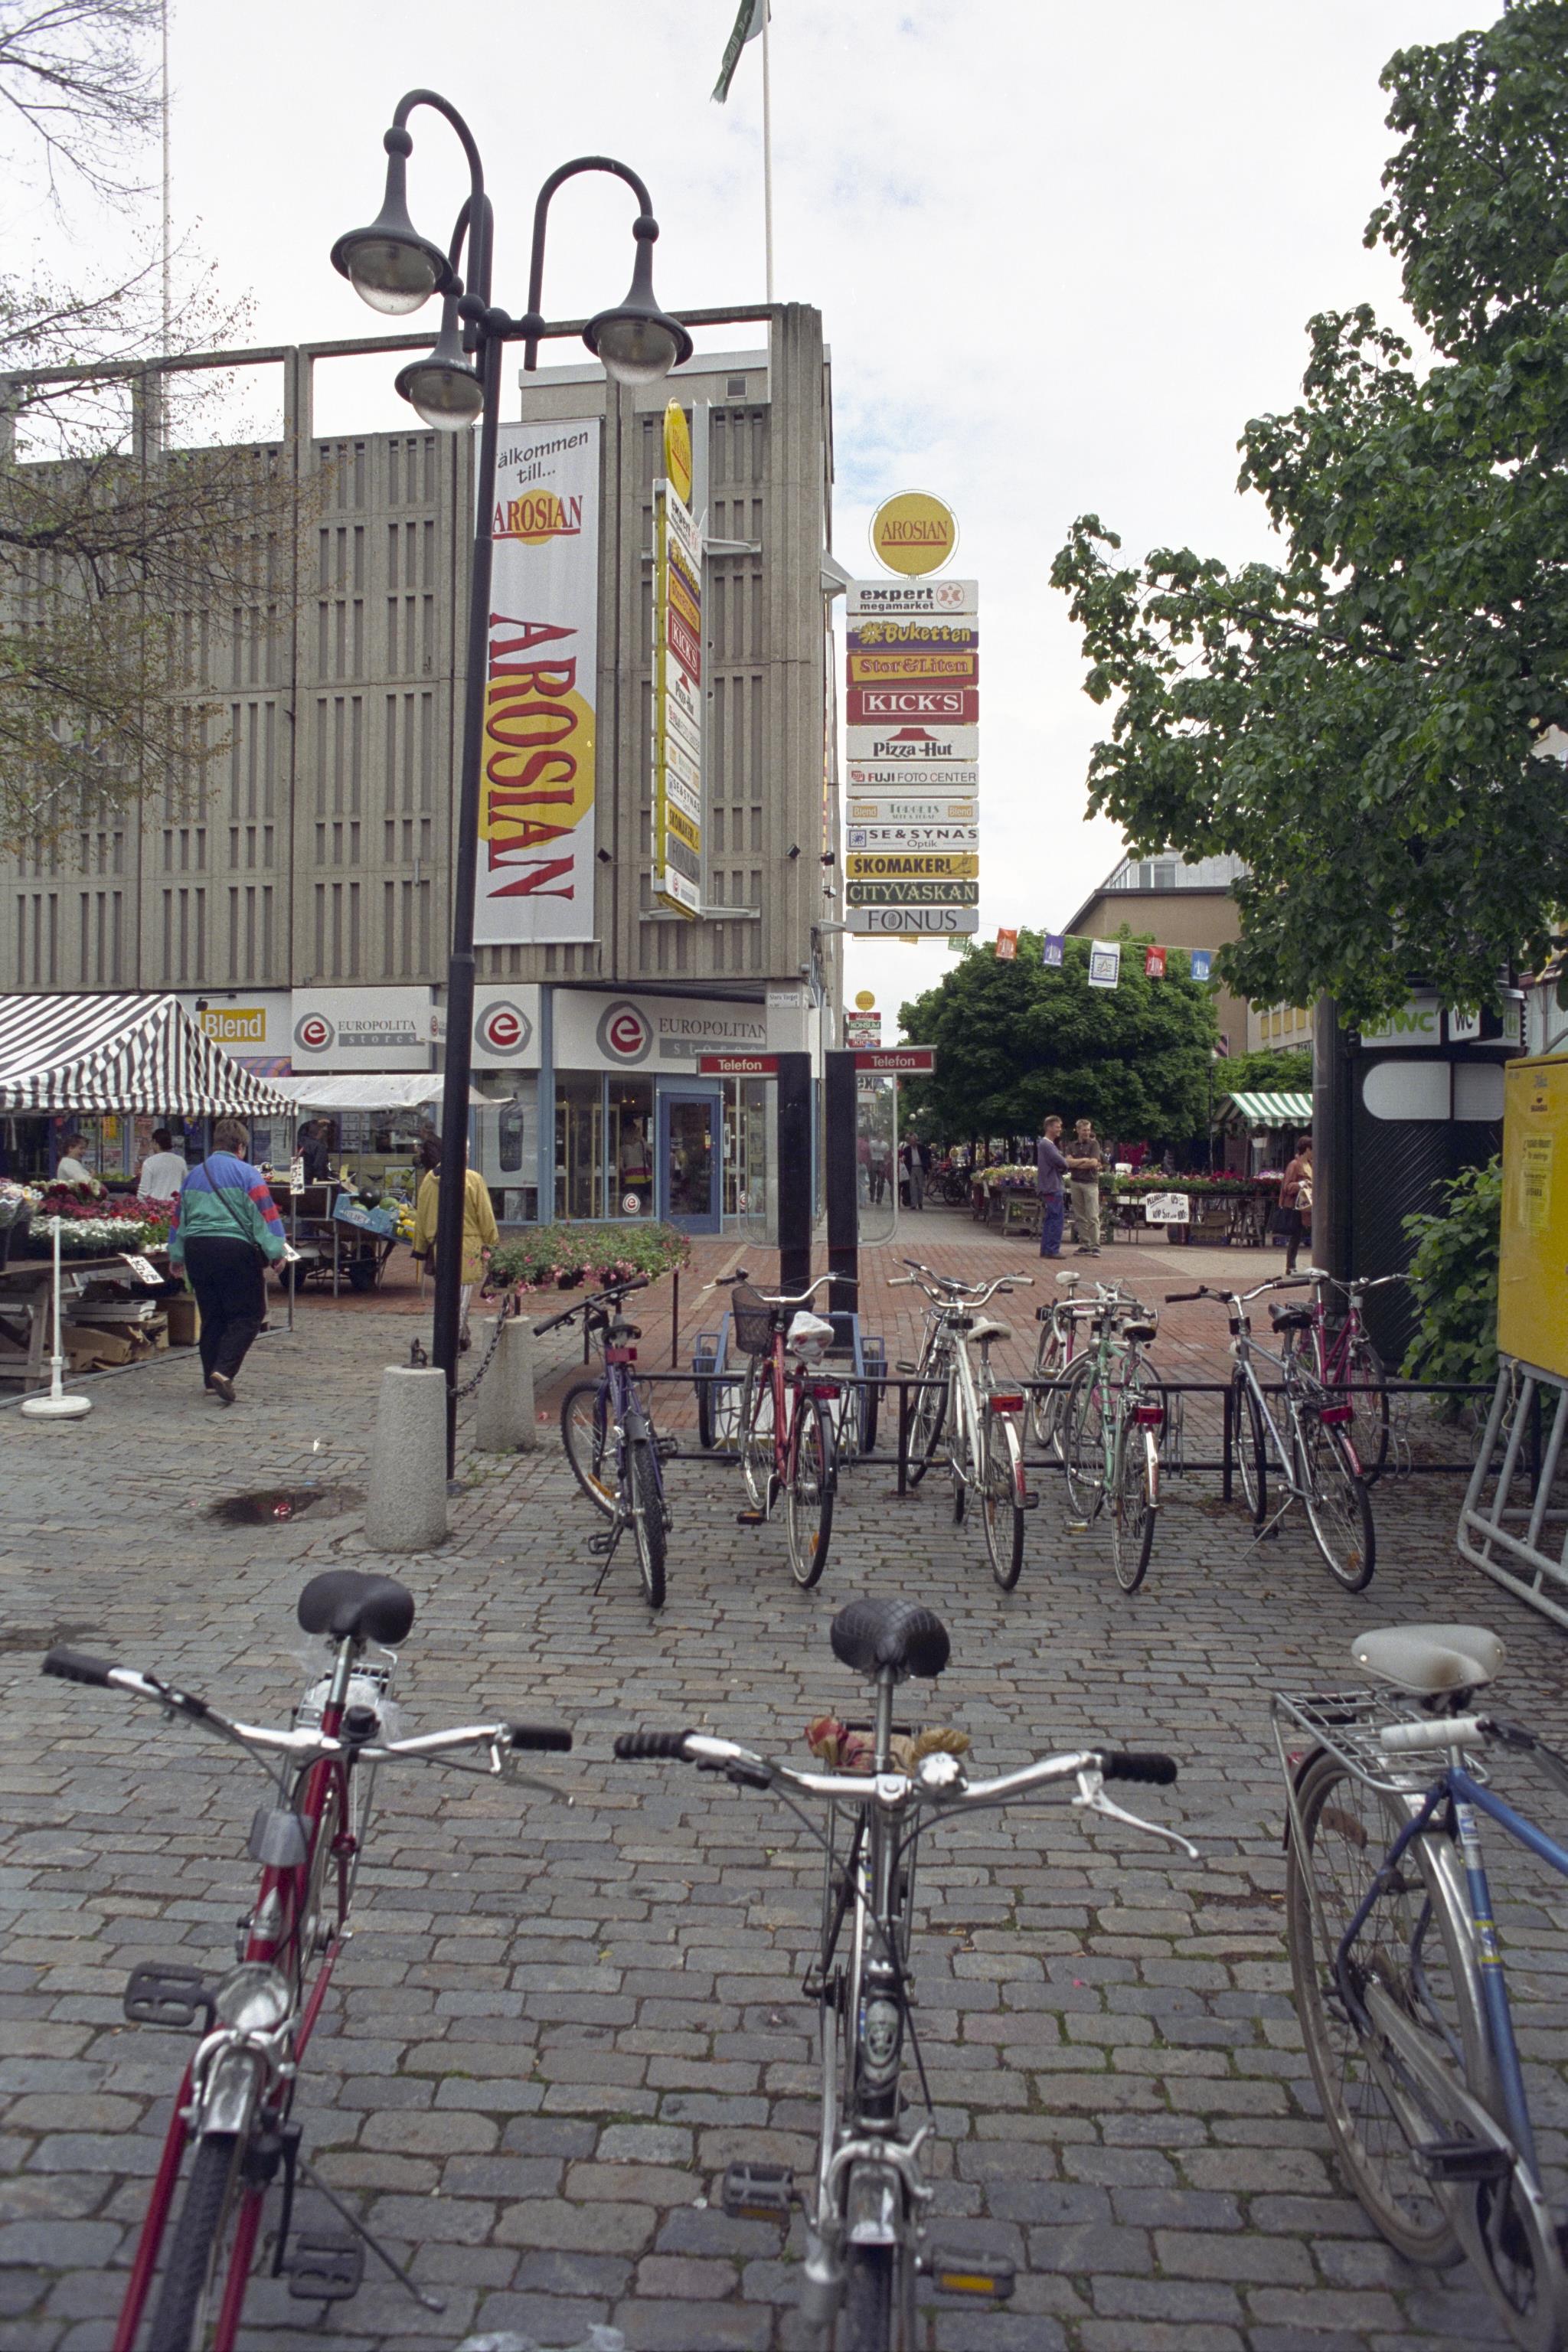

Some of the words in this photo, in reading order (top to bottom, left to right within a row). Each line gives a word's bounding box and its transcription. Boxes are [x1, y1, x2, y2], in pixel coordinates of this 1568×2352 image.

[495, 431, 589, 469] älkommen
[492, 495, 583, 533] AROSIAN
[881, 520, 948, 540] AROSIAN
[860, 586, 933, 602] expert
[860, 601, 934, 611] megamarket
[884, 622, 971, 645] Buketten
[486, 612, 579, 900] AROSIAN
[874, 742, 916, 757] Pizza
[919, 742, 952, 757] Hut
[868, 773, 895, 782] FUJI
[897, 773, 927, 782] FOTO
[929, 773, 976, 782] CENTER
[854, 806, 877, 817] Blend
[949, 806, 972, 817] Blend
[907, 839, 938, 849] Optik
[854, 858, 951, 874] SKOMAKERI
[849, 881, 975, 901] CITYVÄSKAN
[867, 910, 957, 930] FONUS
[204, 1014, 262, 1037] Blend
[338, 1021, 416, 1031] EUROPOLITA
[488, 1013, 521, 1046] e
[659, 1018, 766, 1038] EUROPOLITAN
[851, 1021, 880, 1030] KONSUM
[1393, 1011, 1434, 1033] WC
[1455, 1008, 1473, 1032] WC
[348, 1034, 416, 1044] stores
[610, 1015, 643, 1053] e
[717, 1059, 763, 1070] Telefon
[871, 1055, 916, 1067] Telefon
